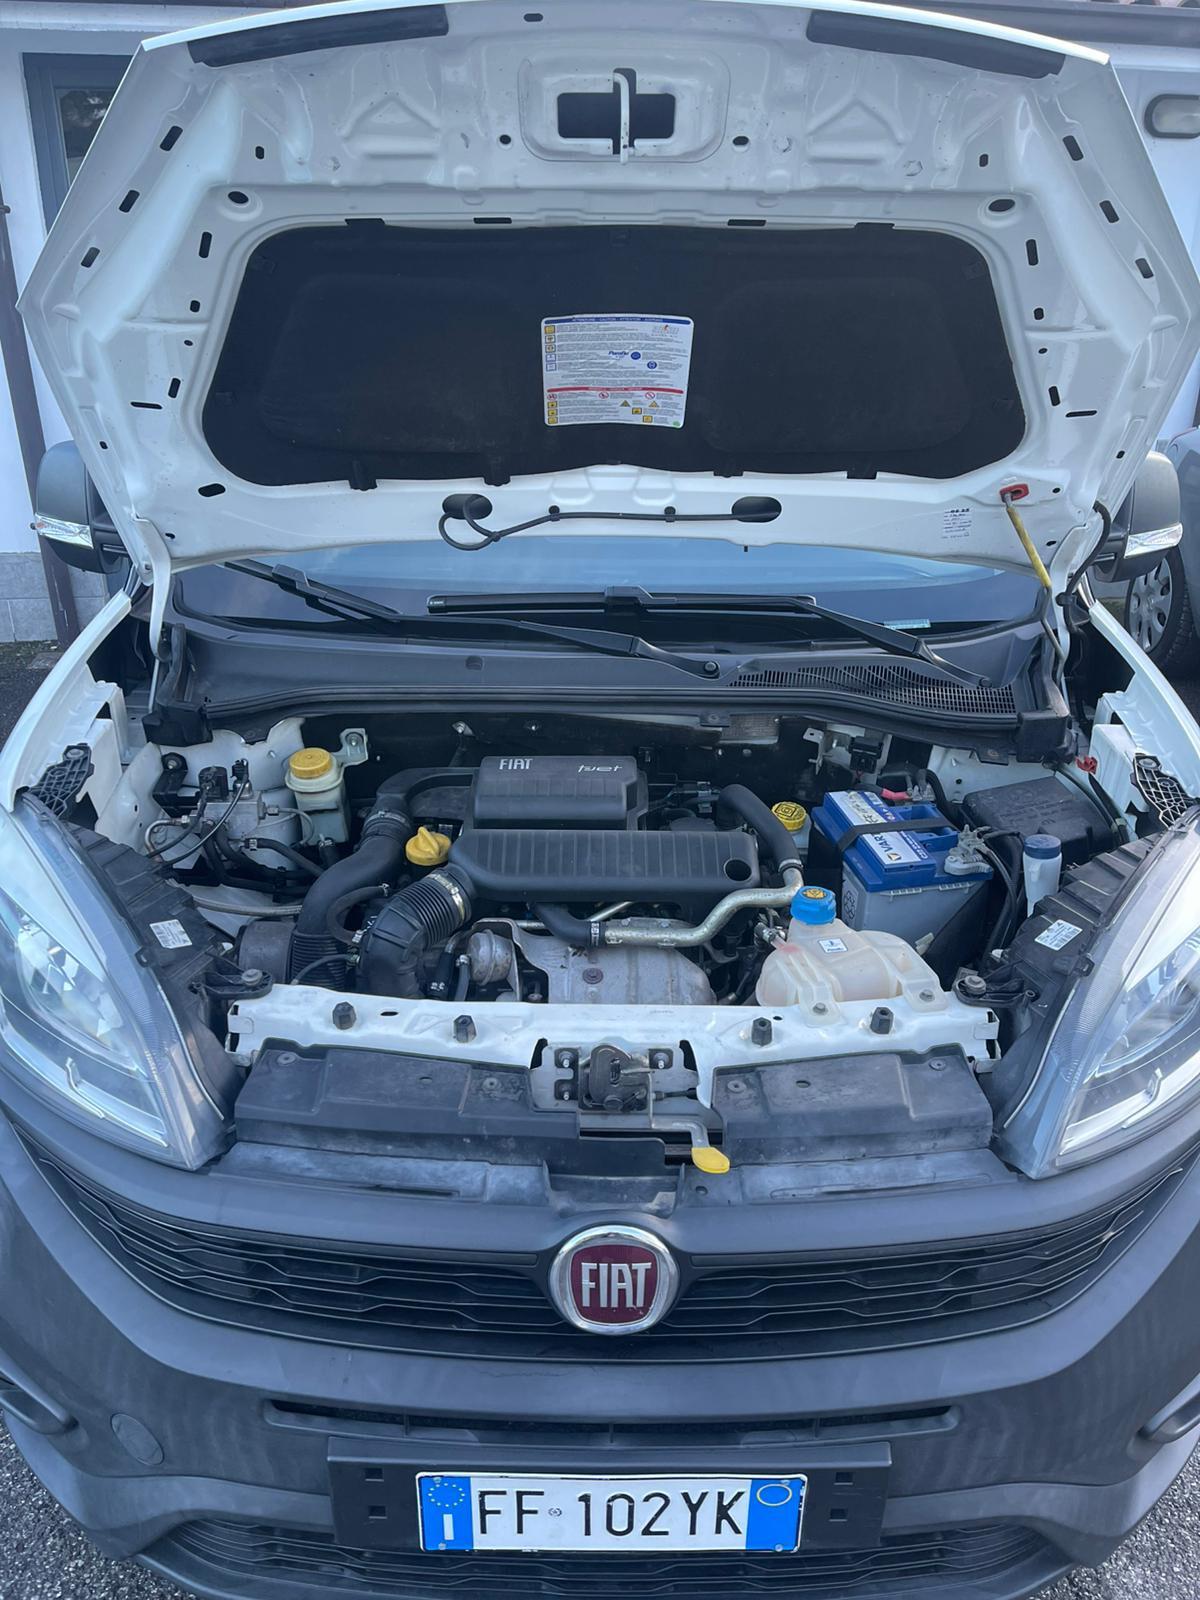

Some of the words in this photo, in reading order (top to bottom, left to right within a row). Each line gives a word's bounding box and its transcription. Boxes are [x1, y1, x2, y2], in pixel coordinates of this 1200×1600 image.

[499, 758, 533, 770] FIAT
[581, 1262, 652, 1308] FIAT
[478, 1490, 545, 1536] FF
[577, 1490, 746, 1537] 102YK
